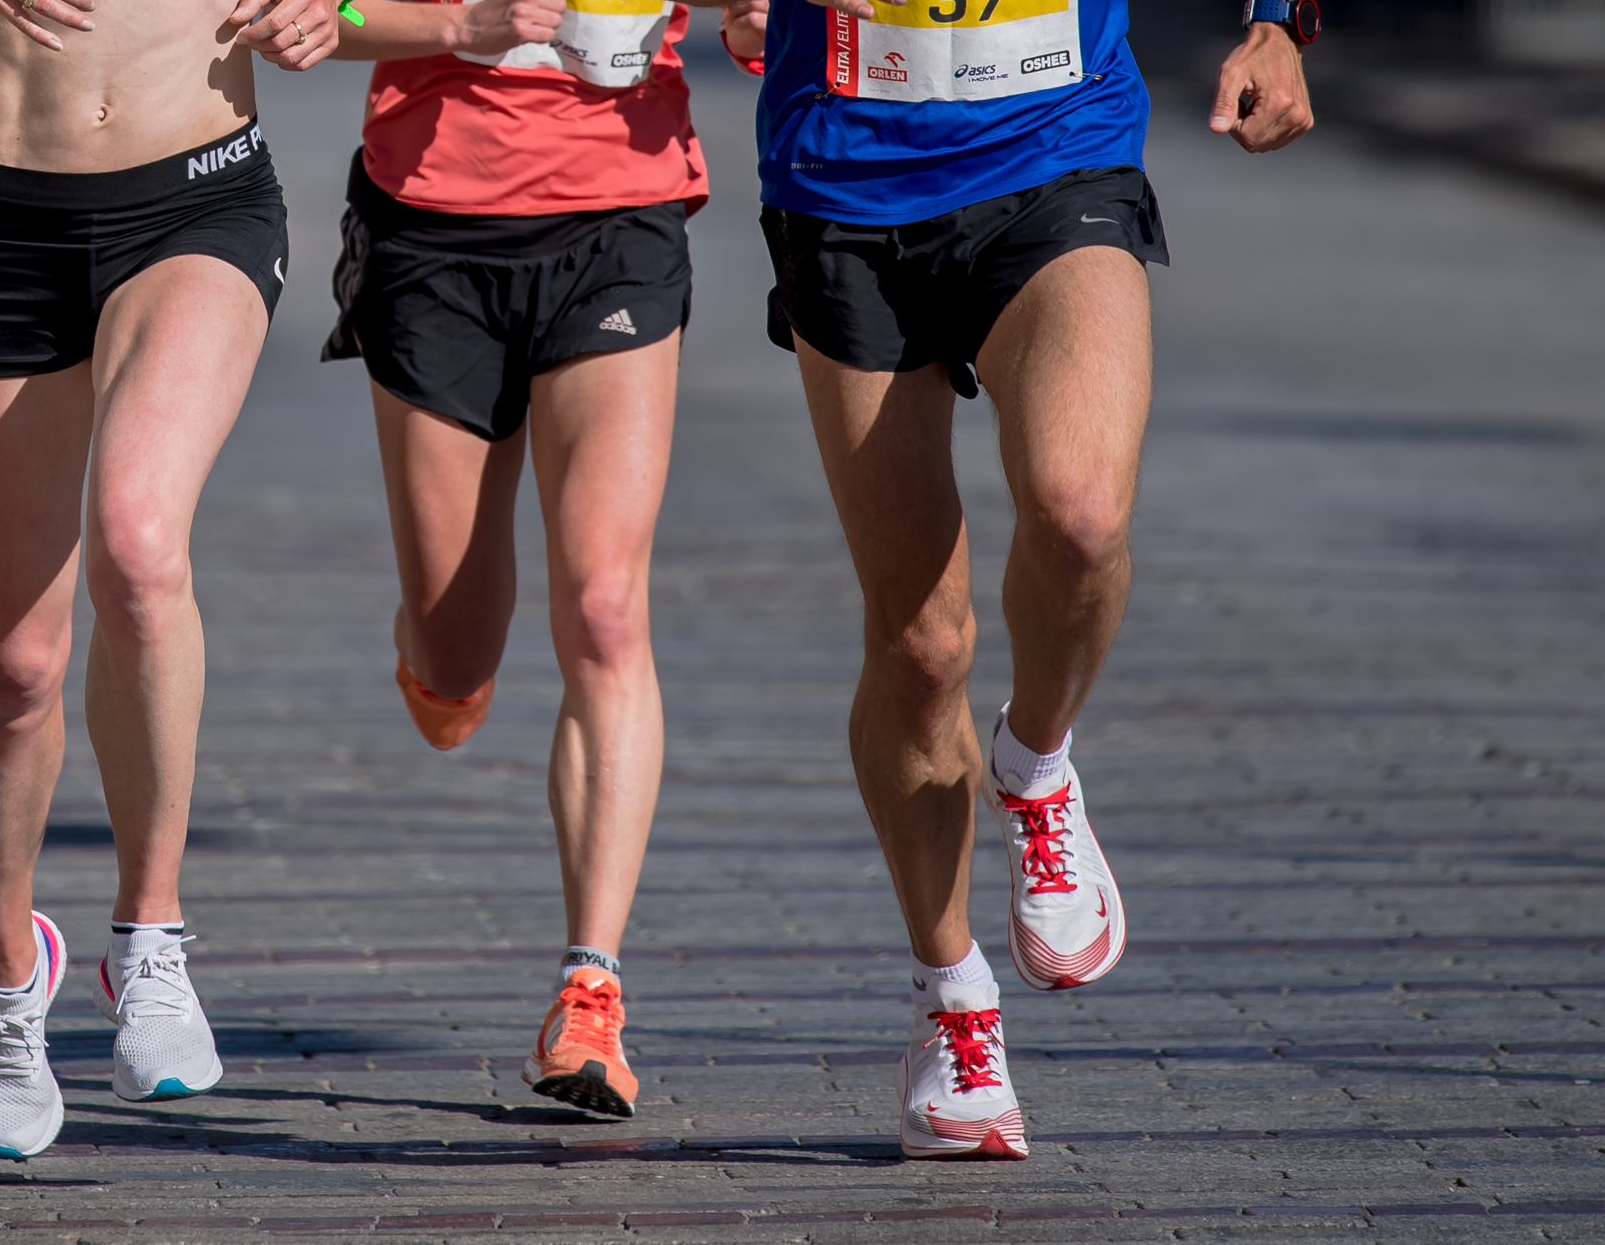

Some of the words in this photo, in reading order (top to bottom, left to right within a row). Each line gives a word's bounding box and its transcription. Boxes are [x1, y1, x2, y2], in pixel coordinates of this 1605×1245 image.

[837, 9, 850, 42] ELITE
[837, 52, 850, 84] ELITA
[968, 64, 996, 76] asics
[1023, 52, 1069, 72] OSHEE
[869, 68, 905, 81] ORLEN
[972, 74, 995, 82] MOVE
[188, 135, 251, 180] NIKE
[790, 162, 824, 170] DRI-FIT
[599, 321, 637, 335] adidas
[568, 950, 609, 970] ROYAL
